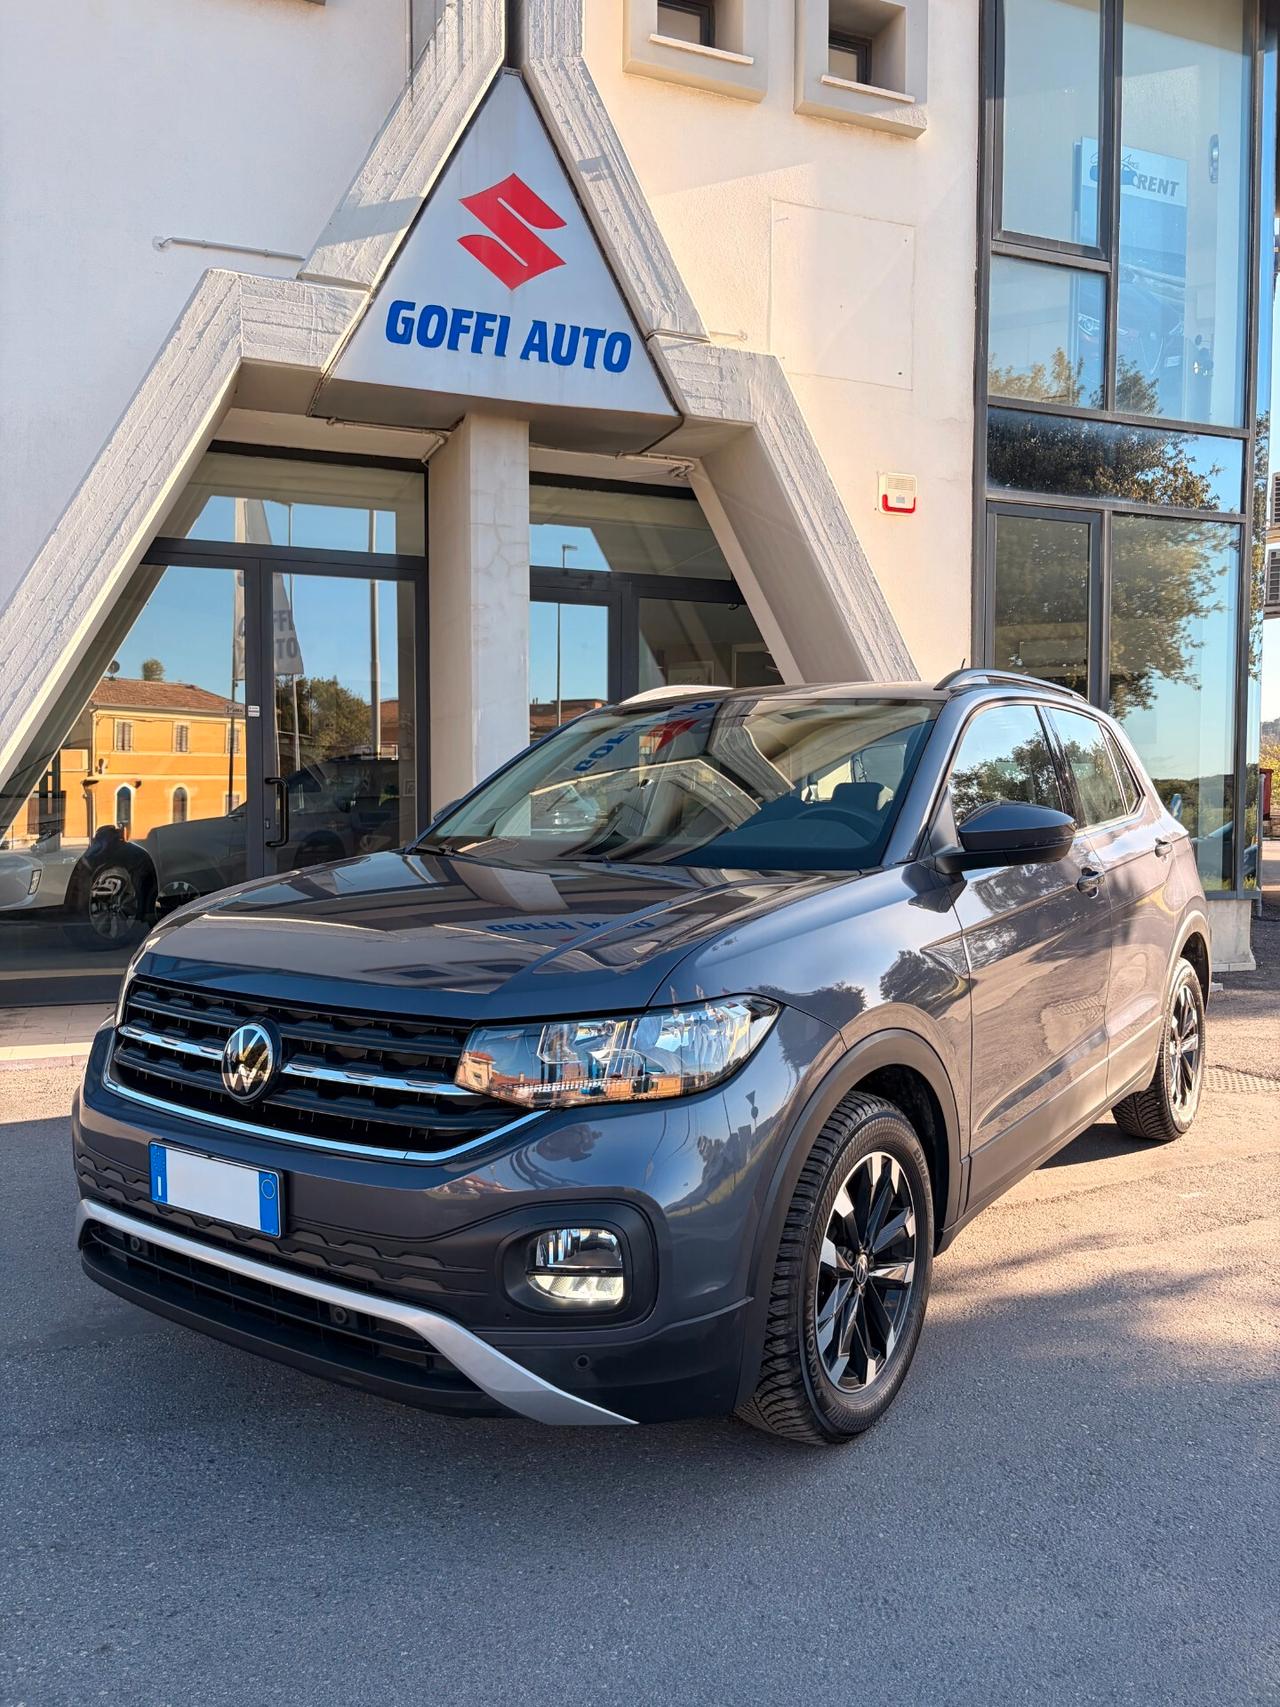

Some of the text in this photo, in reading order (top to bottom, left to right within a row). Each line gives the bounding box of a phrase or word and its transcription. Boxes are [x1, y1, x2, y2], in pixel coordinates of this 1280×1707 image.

[1137, 173, 1180, 197] RENT
[385, 299, 632, 374] GOFFI AUTO
